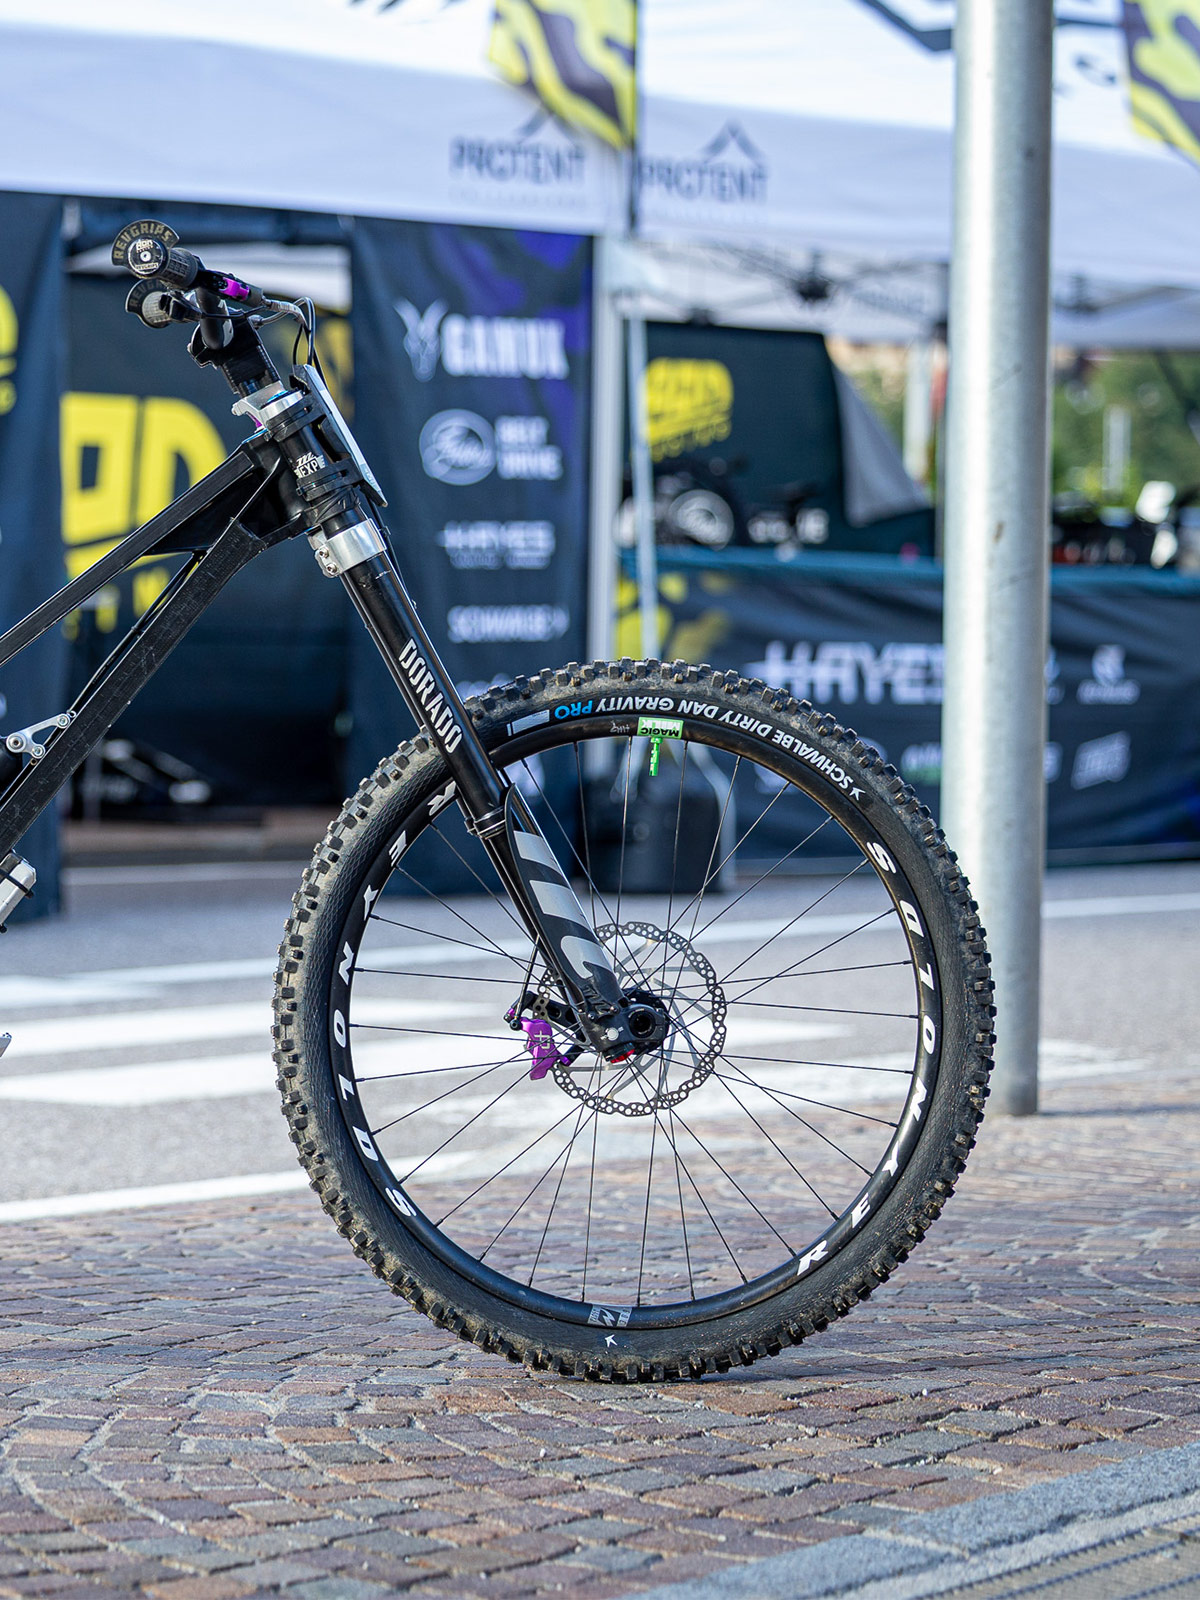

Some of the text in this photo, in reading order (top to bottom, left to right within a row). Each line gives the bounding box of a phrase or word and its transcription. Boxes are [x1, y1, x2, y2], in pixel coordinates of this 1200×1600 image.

[113, 222, 173, 260] REVGRIPS
[398, 638, 464, 754] DORADO
[554, 696, 856, 791] SCHWALBE DIRTY DAN GRAVITY PRO
[640, 719, 681, 731] MILK
[640, 728, 680, 737] MAGIC
[332, 781, 457, 1219] REYNOLDS
[796, 842, 936, 1276] REYNOLDS
